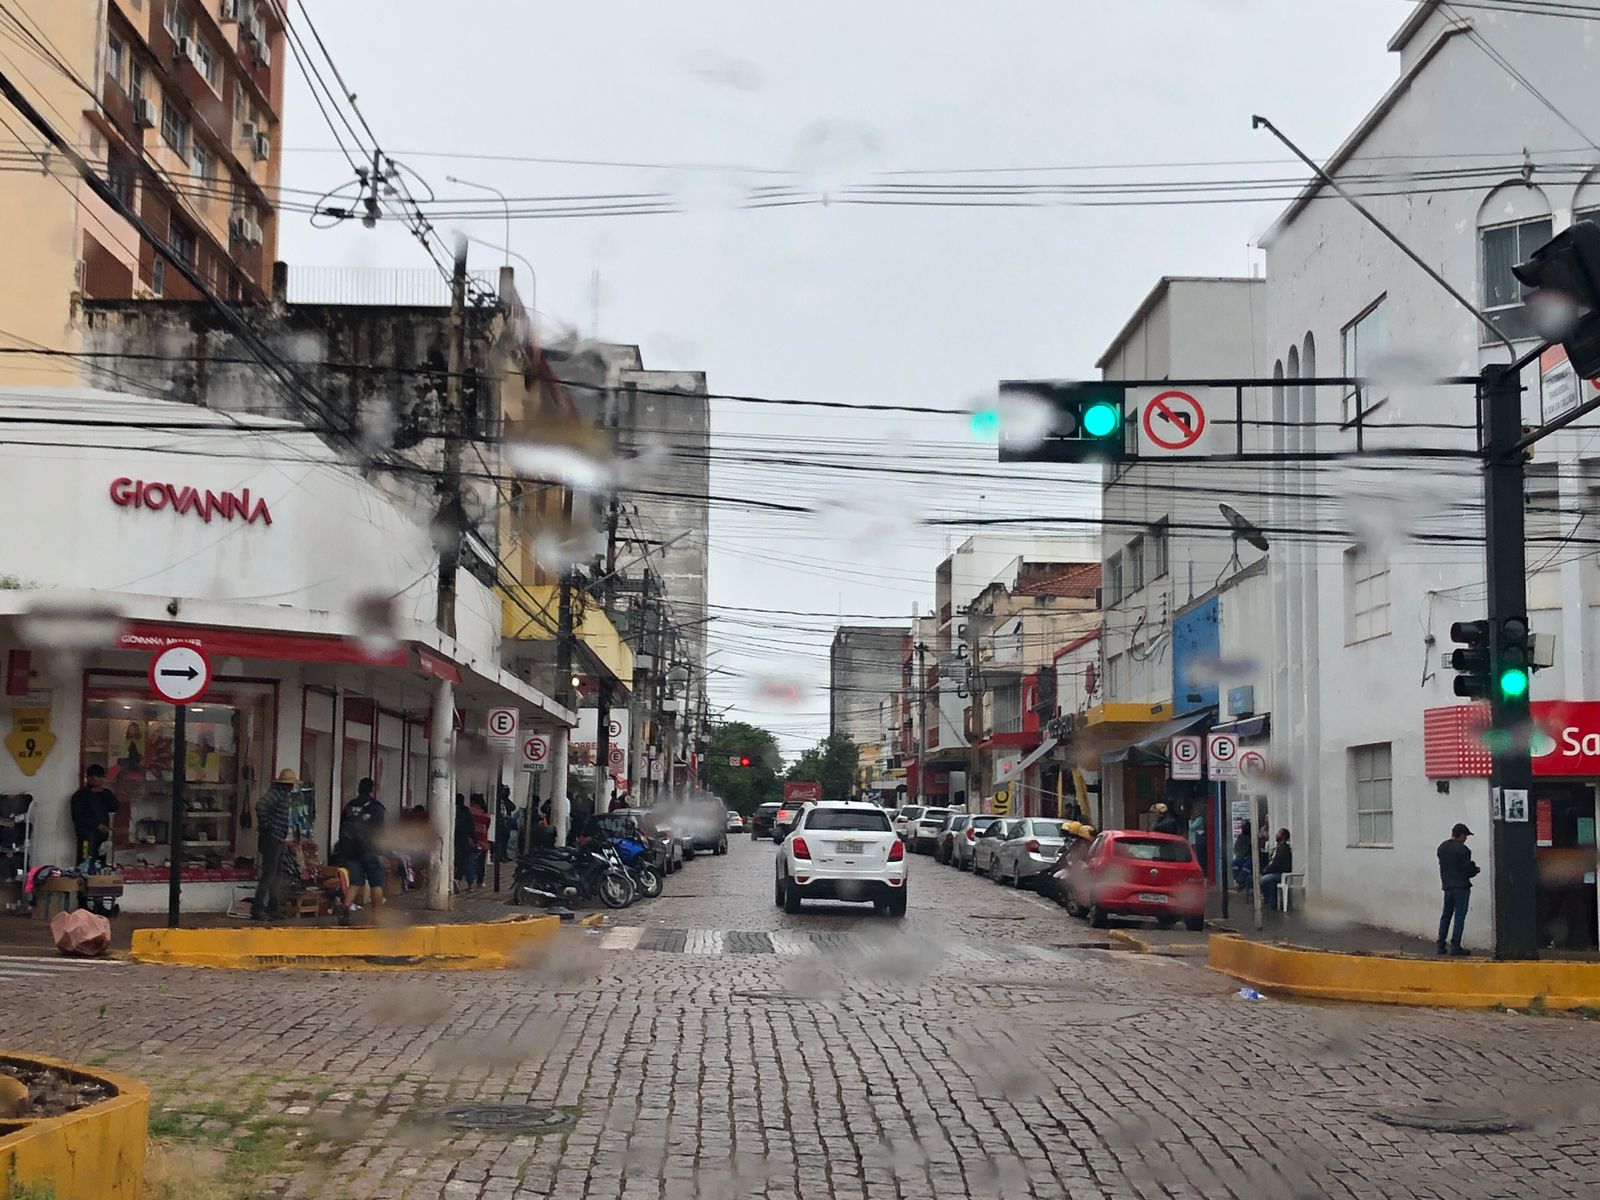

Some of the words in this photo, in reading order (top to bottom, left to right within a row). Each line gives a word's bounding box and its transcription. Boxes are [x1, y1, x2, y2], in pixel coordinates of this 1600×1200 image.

[110, 476, 273, 526] GIOVANNA
[121, 634, 164, 646] GIOVANNA
[498, 716, 507, 730] E
[1561, 726, 1600, 756] Sa
[1182, 744, 1190, 757] E
[1219, 741, 1228, 756] E
